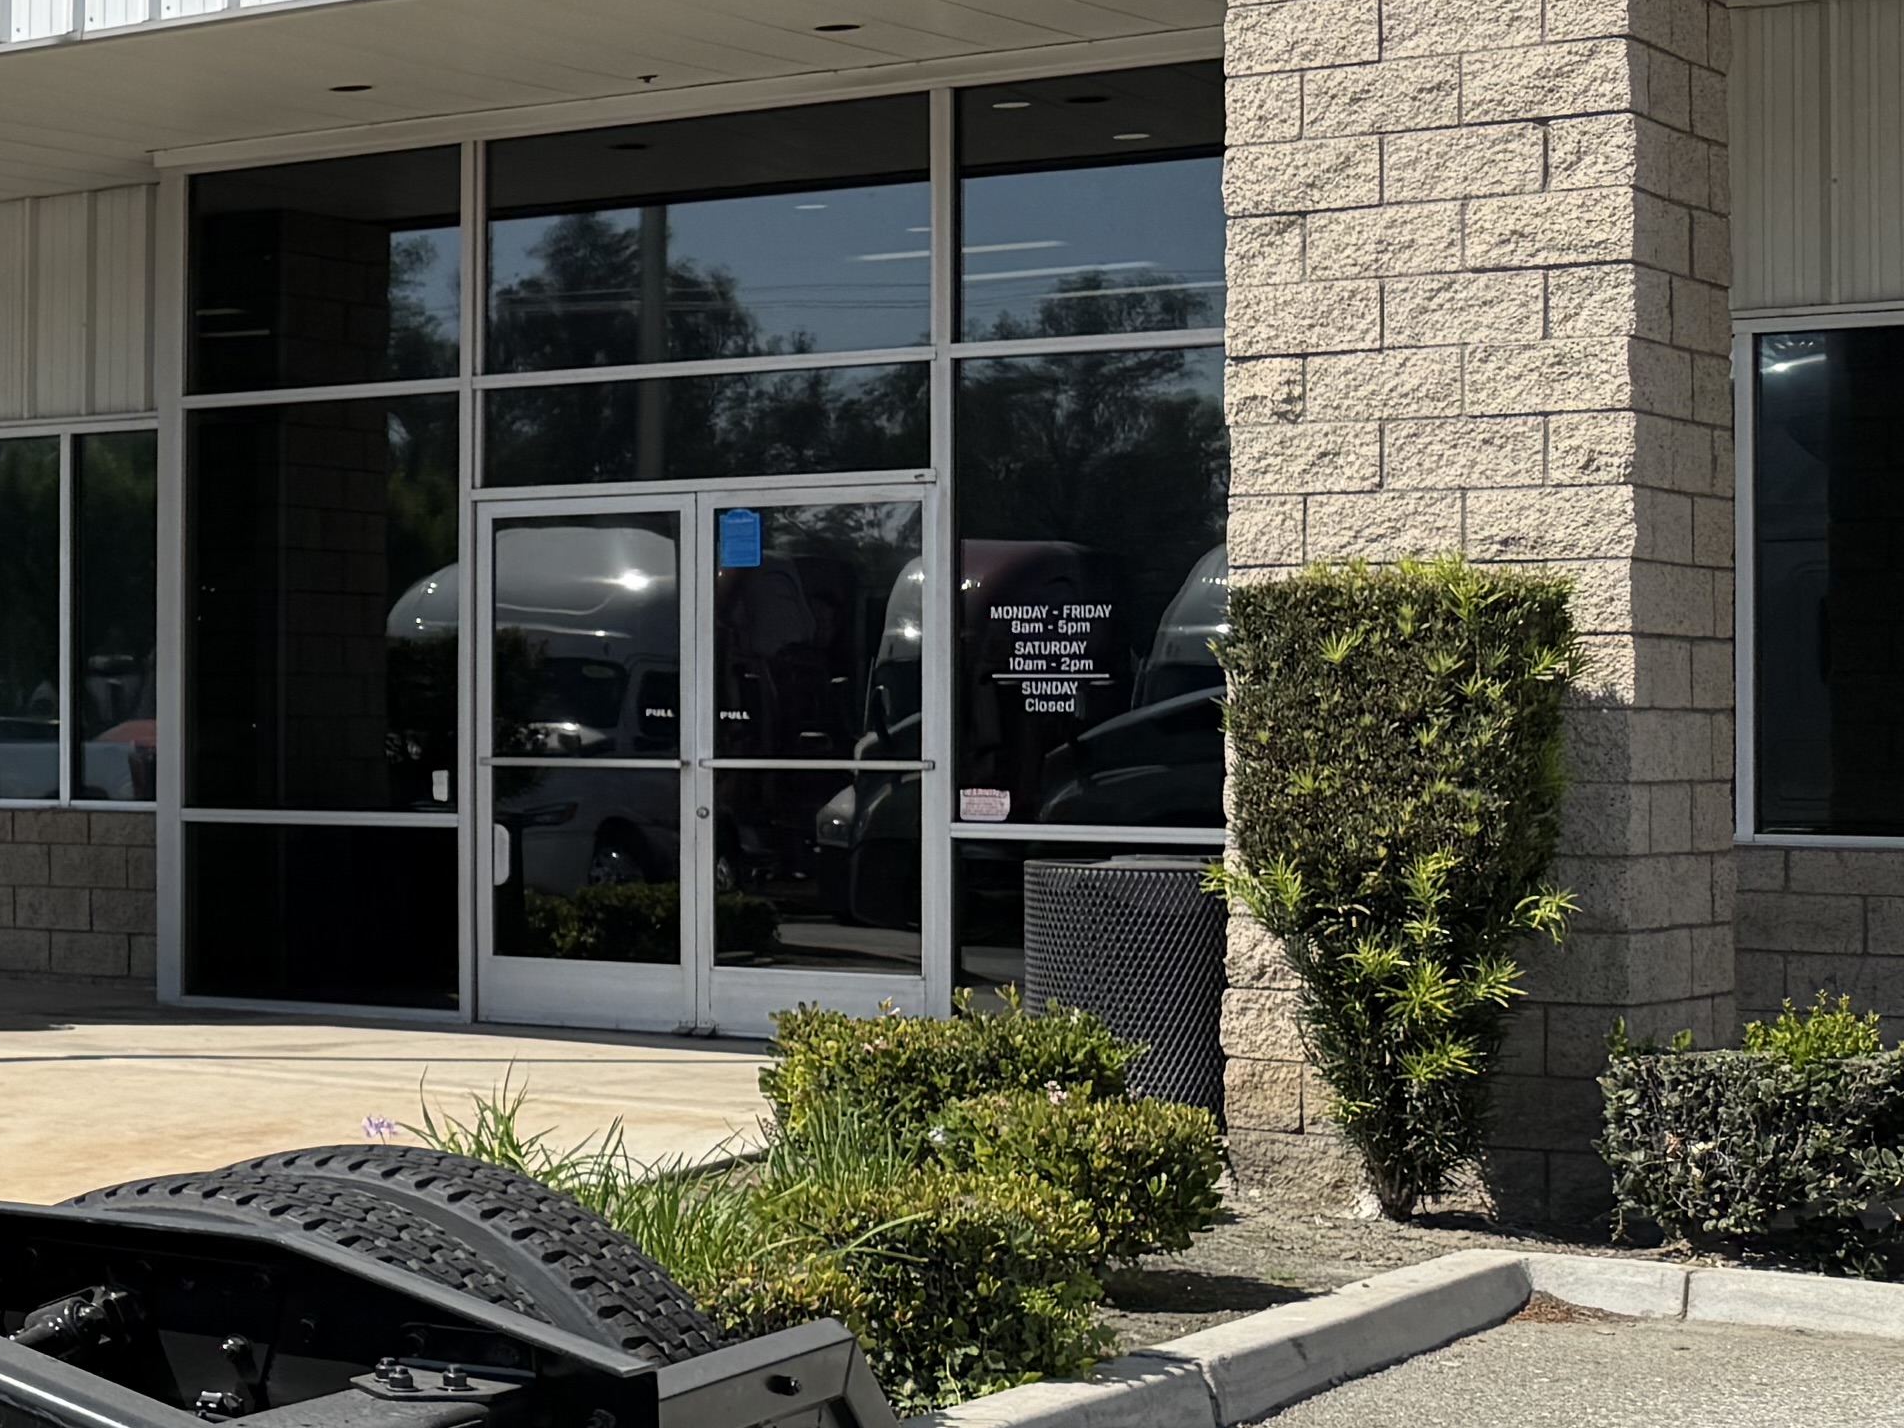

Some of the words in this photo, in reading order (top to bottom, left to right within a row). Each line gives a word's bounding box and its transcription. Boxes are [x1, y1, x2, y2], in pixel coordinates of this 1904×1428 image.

[990, 604, 1049, 619] MONDAY
[1062, 604, 1112, 619] FRIDAY
[1011, 620, 1043, 633] 8am
[1057, 619, 1091, 636] 5pm
[1014, 640, 1087, 655] SATURDAY
[1009, 657, 1046, 671] 10am
[1060, 657, 1093, 673] 2pm
[1021, 681, 1078, 695] SUNDAY
[1025, 698, 1075, 712] Closed
[645, 708, 674, 717] PULL
[719, 710, 750, 720] PULL
